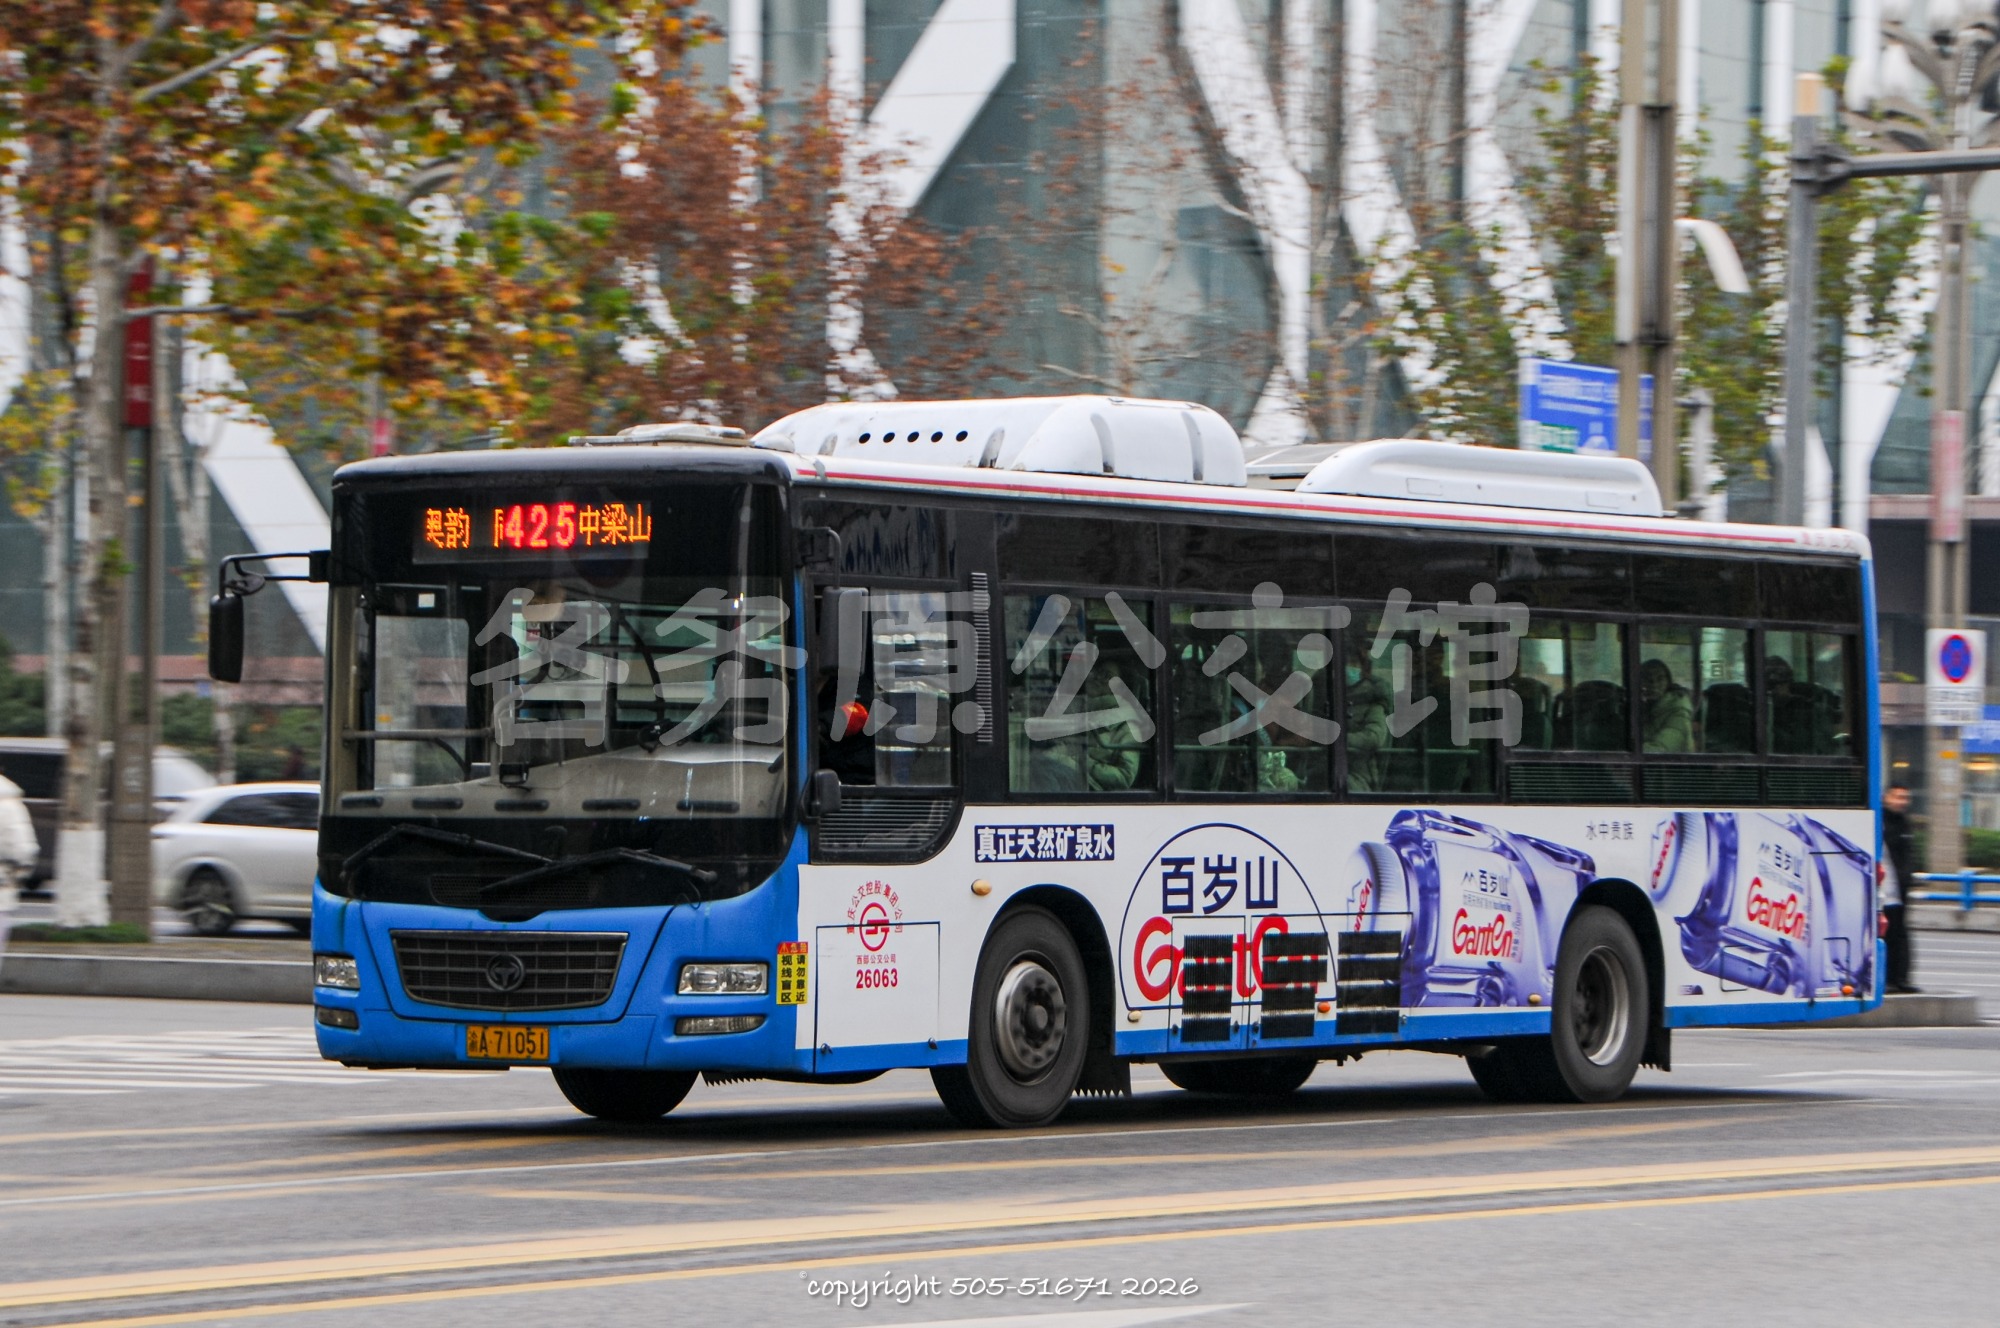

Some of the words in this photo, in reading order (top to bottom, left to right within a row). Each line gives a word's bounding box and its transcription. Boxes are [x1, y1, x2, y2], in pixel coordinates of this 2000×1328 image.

[504, 504, 576, 548] 425
[579, 503, 651, 546] 中梁山
[976, 826, 1113, 861] 真正天然矿泉水
[1586, 820, 1634, 840] 水中贵族
[1160, 853, 1279, 915] 百岁山
[1746, 876, 1805, 940] Ganten
[1452, 907, 1514, 958] Ganten
[781, 954, 793, 1003] 视线盲区
[796, 954, 806, 1002] 请勿靠近
[856, 953, 897, 965] 西部公交公司
[856, 967, 898, 989] 26063
